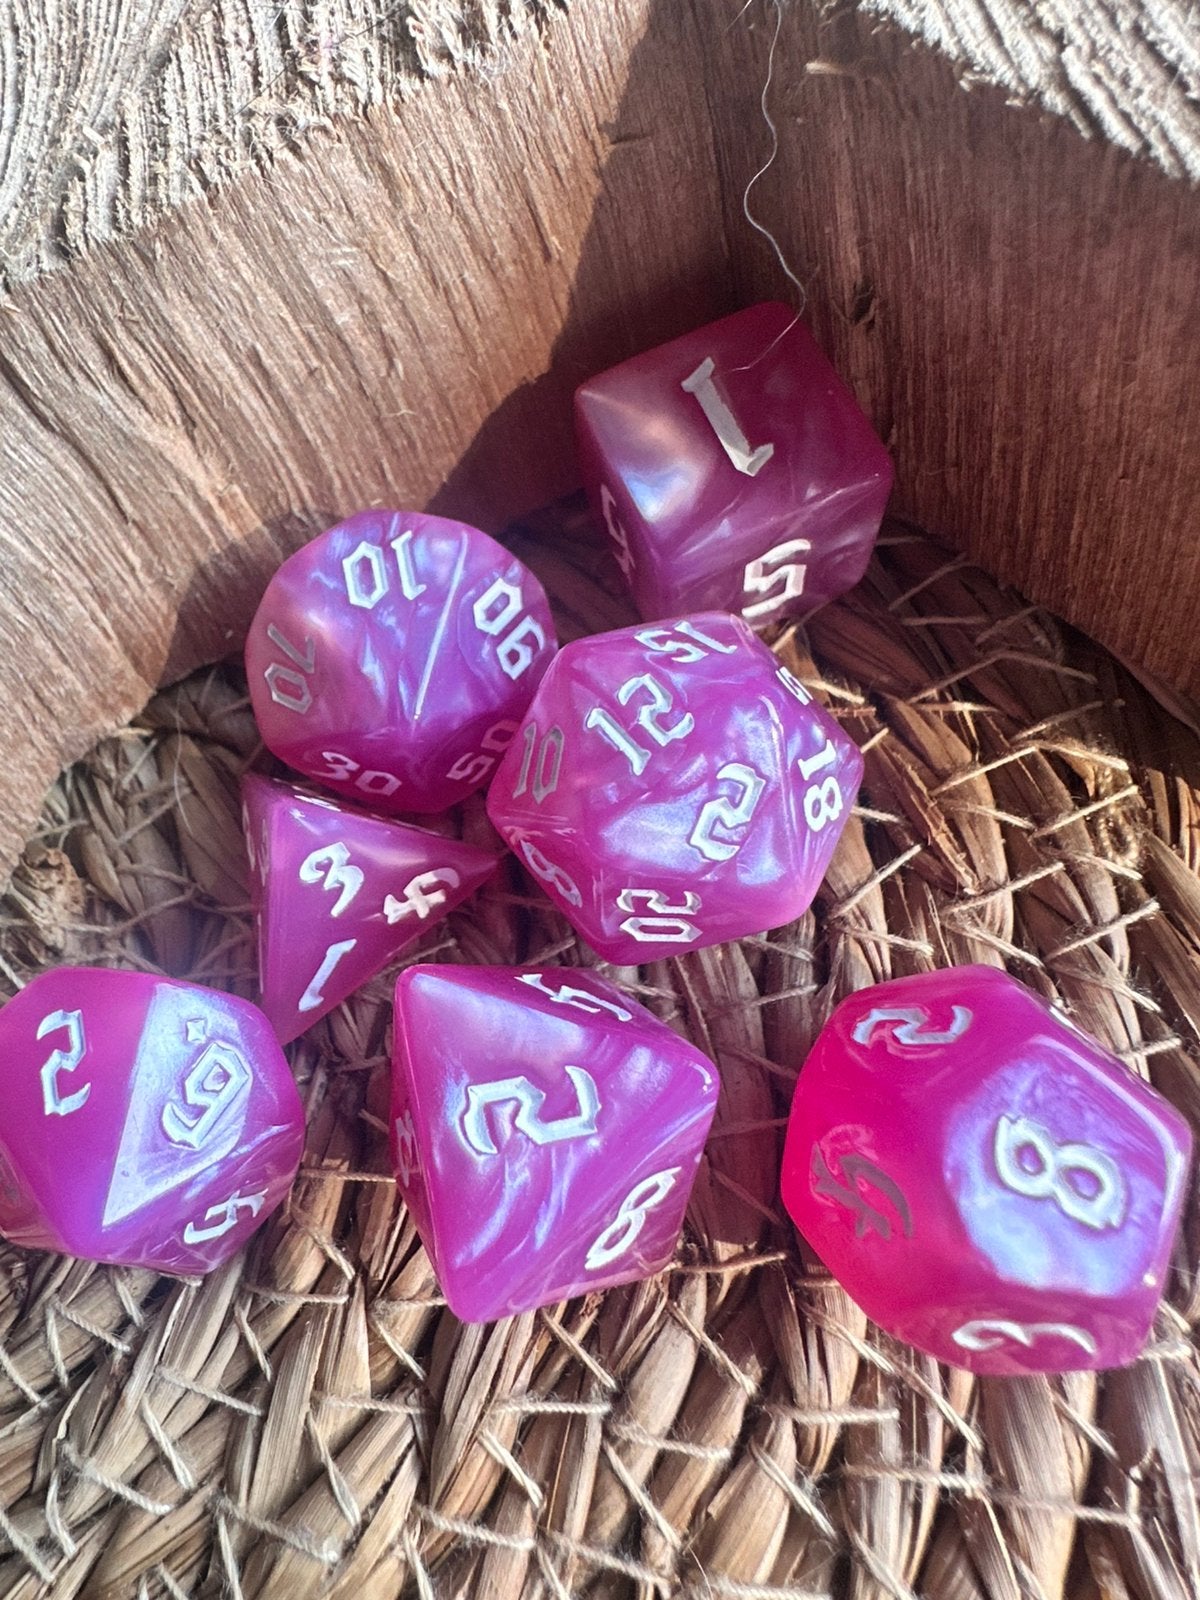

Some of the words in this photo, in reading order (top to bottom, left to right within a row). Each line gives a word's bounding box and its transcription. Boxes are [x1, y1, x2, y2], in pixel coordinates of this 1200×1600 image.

[680, 356, 774, 477] 1
[342, 530, 427, 609] 10
[741, 538, 811, 618] 5
[264, 624, 315, 714] 70
[473, 578, 545, 680] 90
[634, 621, 737, 663] 15
[511, 721, 565, 804] 10
[585, 673, 695, 776] 12
[311, 751, 402, 795] 30
[689, 762, 766, 862] 2
[798, 739, 843, 832] 18
[299, 842, 364, 917] 3
[383, 867, 460, 924] 4
[521, 840, 583, 908] 8
[616, 889, 702, 942] 20
[298, 938, 357, 1012] 1
[514, 973, 632, 1021] 4
[36, 1009, 91, 1116] 2
[851, 1005, 972, 1046] 2
[460, 1064, 602, 1156] 2
[812, 1141, 914, 1240] 4
[994, 1112, 1128, 1230] 8
[183, 1188, 269, 1245] 4
[584, 1166, 682, 1270] 8
[951, 1319, 1098, 1356] 3
